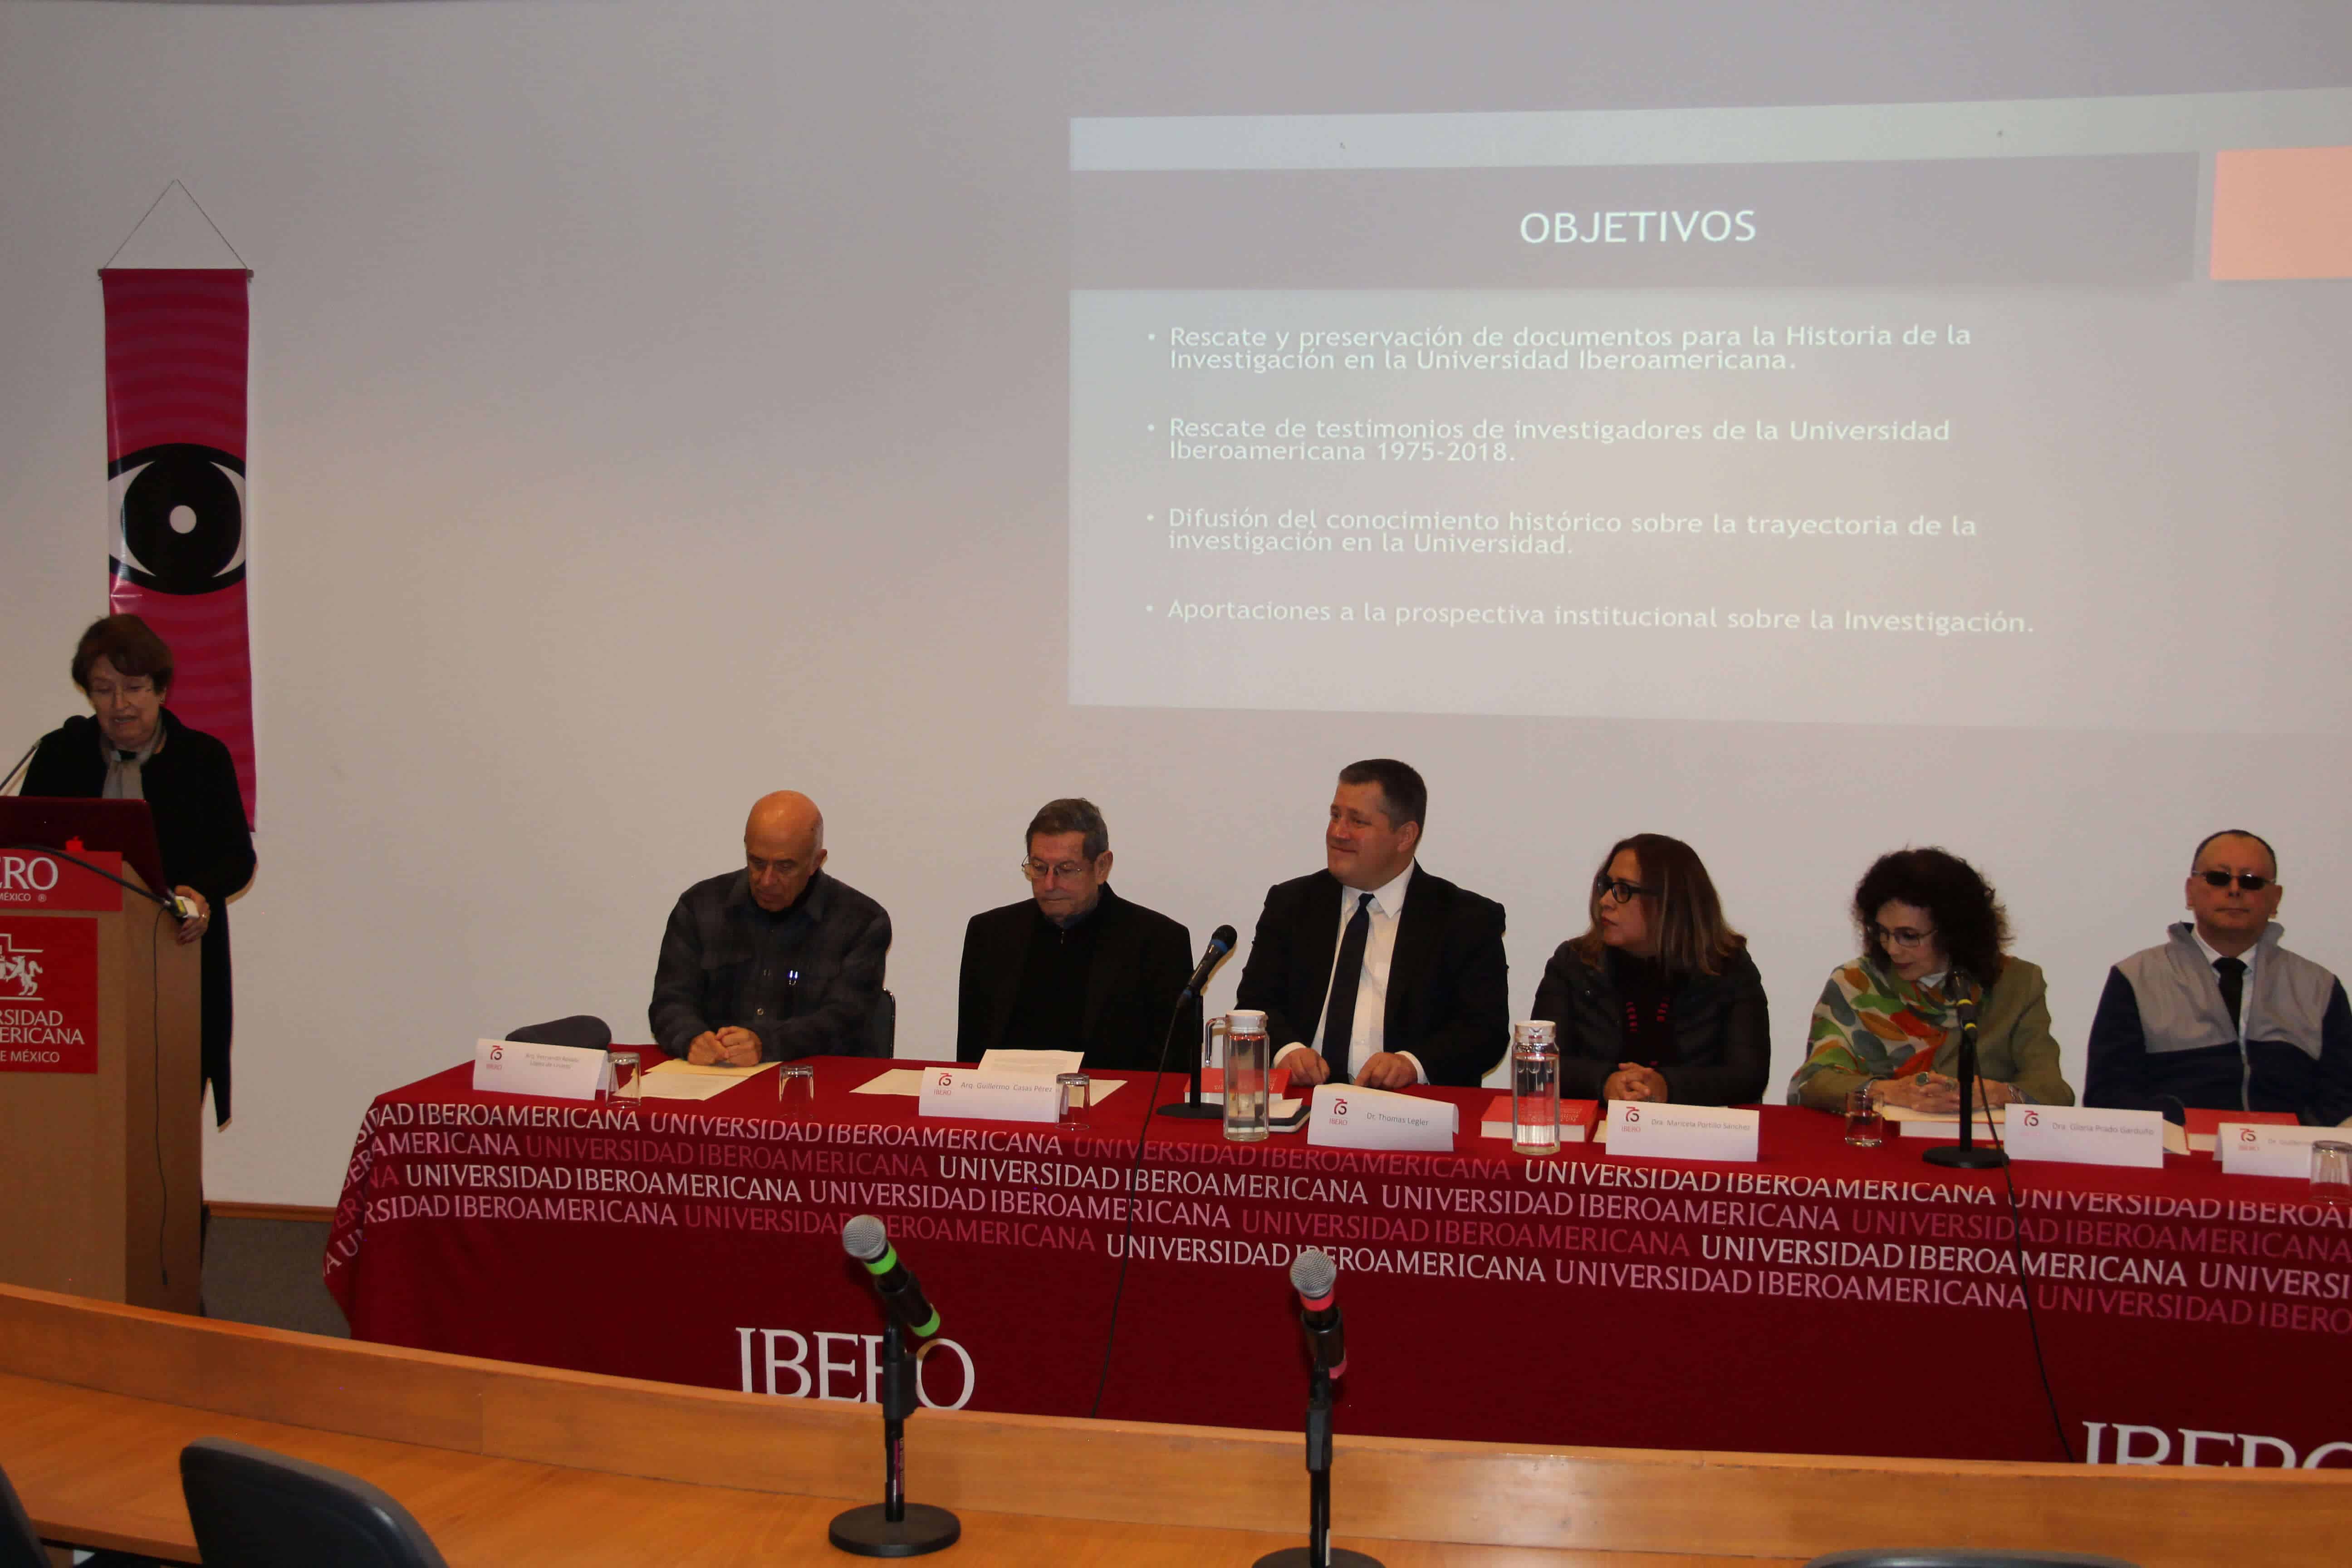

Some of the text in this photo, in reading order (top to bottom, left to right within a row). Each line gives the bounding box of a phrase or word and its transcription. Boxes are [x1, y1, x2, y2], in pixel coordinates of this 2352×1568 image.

[1519, 209, 1758, 245] OBJETIVOS
[1171, 324, 1970, 352] Rescate y preservación de documentos para la Historia de la
[1171, 349, 1796, 373] Investigación en la Universidad Iberoamericana.
[1171, 418, 1950, 444] Rescate de testimonios de investigadores de la Universidad
[1171, 441, 1514, 462] Iberoamericana 1975-2018.
[1169, 508, 1976, 539] Difusión del conocimiento histórico sobre la trayectoria de la
[1169, 530, 1573, 555] investigación en la Universidad.
[1168, 600, 2034, 636] Aportaciones a la prospectiva institucional sobre la Investigación.
[0, 856, 59, 890] RO
[11, 1049, 60, 1063] MÉXICO
[976, 1082, 1010, 1091] Guillermo
[1034, 1085, 1053, 1093] Pérez
[1329, 1117, 1348, 1126] IBERO
[1379, 1114, 1406, 1123] Thomas
[1407, 1116, 1430, 1126] Legler
[1697, 1121, 1721, 1129] Portillo
[355, 1103, 2352, 1229] SIDAD IBEROAMERICANA UNIVERSIDAD IBEROAMERICANA UNIVERSIDAD IBEROAMERICANA UNIVERSIDAD IBEROAMERICANA UNIVERSIDAD IBEROA
[526, 1136, 694, 1165] UNIVERSIDAD
[700, 1143, 929, 1178] IBEROAMERICANA
[940, 1155, 1118, 1190] UNIVERSIDAD
[1125, 1168, 1368, 1205] IBEROAMERICANA
[1382, 1185, 1573, 1216] UNIVERSIDAD
[1579, 1193, 1840, 1231] IBEROAMERICANA
[1852, 1209, 2059, 1244] UNIVERSIDAD
[2065, 1220, 2352, 1264] IBEROAMERICANA
[406, 1164, 571, 1190] UNIVERSIDAD
[577, 1168, 802, 1202] IBEROAMERICANA
[809, 1180, 985, 1210] UNIVERSIDAD
[991, 1190, 1230, 1228] IBEROAMERICANA
[1242, 1209, 1429, 1243] UNIVERSIDAD
[1435, 1219, 1690, 1257] IBEROAMERICANA
[1702, 1234, 1903, 1268] UNIVERSIDAD
[1909, 1245, 2187, 1287] IBEROAMERICANA
[455, 1195, 678, 1225] IBEROAMERICANA
[870, 1214, 1095, 1251] EROAMERICANA
[1107, 1234, 1289, 1267] UNIVERSIDAD
[1296, 1244, 1545, 1282] IEROAMERICANA
[1556, 1259, 1751, 1293] UNIVERSIDAD
[1757, 1270, 2028, 1309] IBEROAMERICANA
[2037, 1285, 2252, 1325] UNIVERSIDAD
